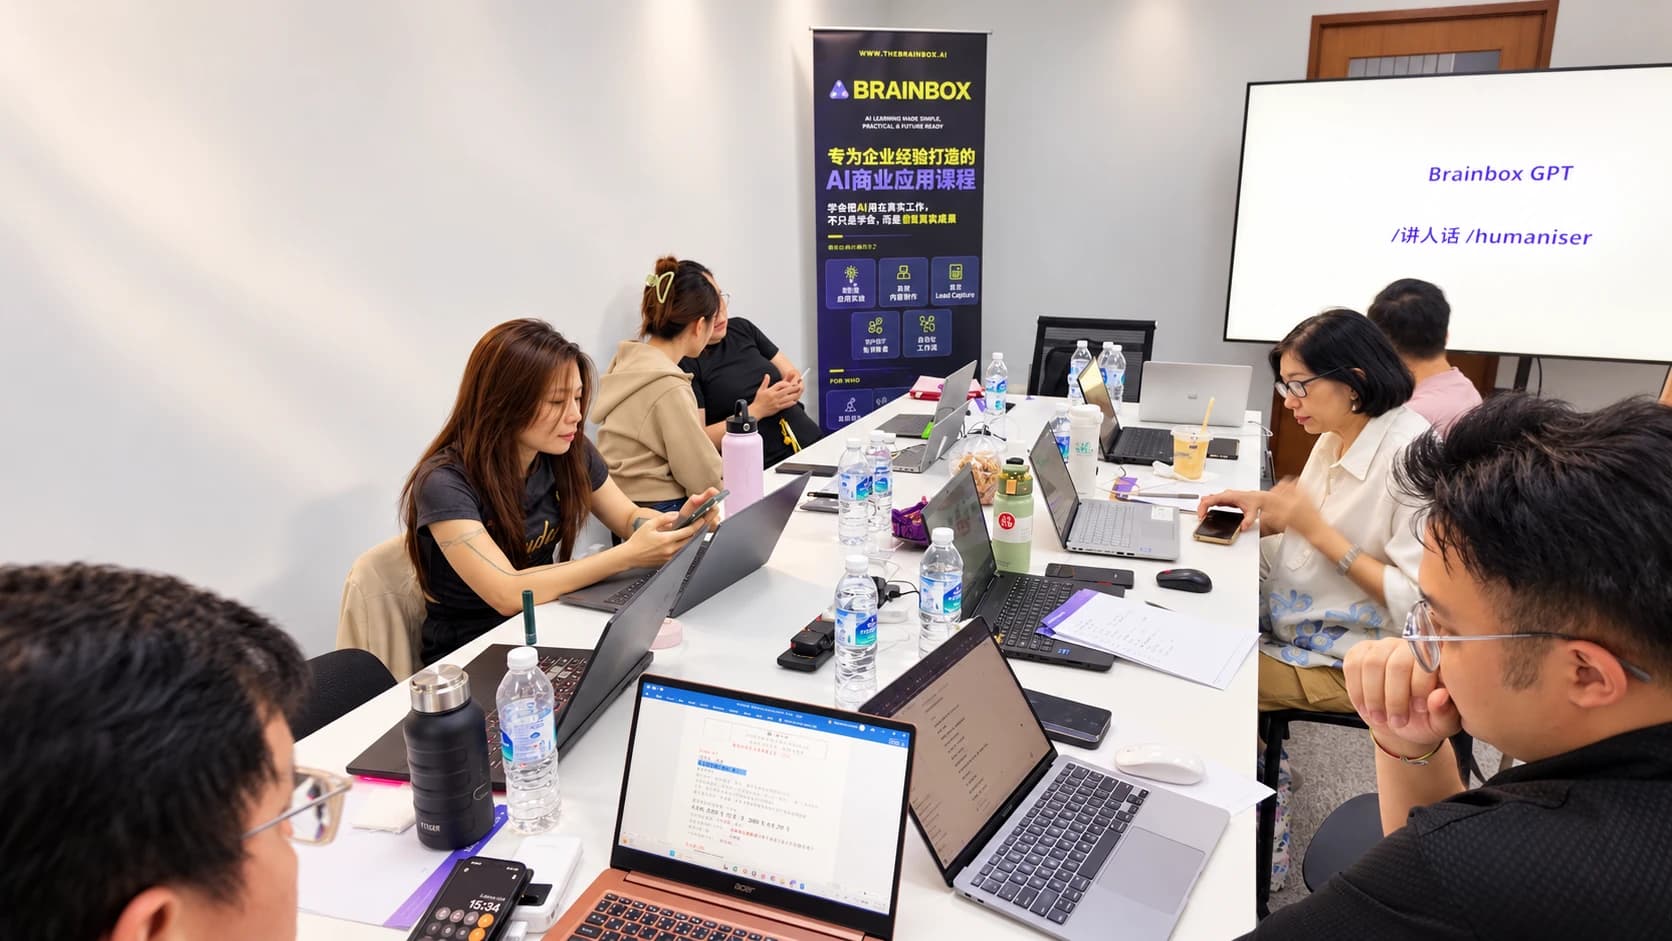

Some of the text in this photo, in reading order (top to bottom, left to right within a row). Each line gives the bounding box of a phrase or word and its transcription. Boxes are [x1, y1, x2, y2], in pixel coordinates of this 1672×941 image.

[859, 50, 947, 58] WWW.THEBRAINBOX.AI
[853, 80, 972, 100] BRAINBOX
[827, 147, 976, 165] 专为企业经验打造的
[826, 168, 977, 191] AI商业应用课程
[1428, 165, 1574, 182] Brainbox GPT
[1391, 226, 1593, 246] /讲人话 /humaniser
[951, 291, 976, 300] Capture
[734, 882, 756, 894] acer
